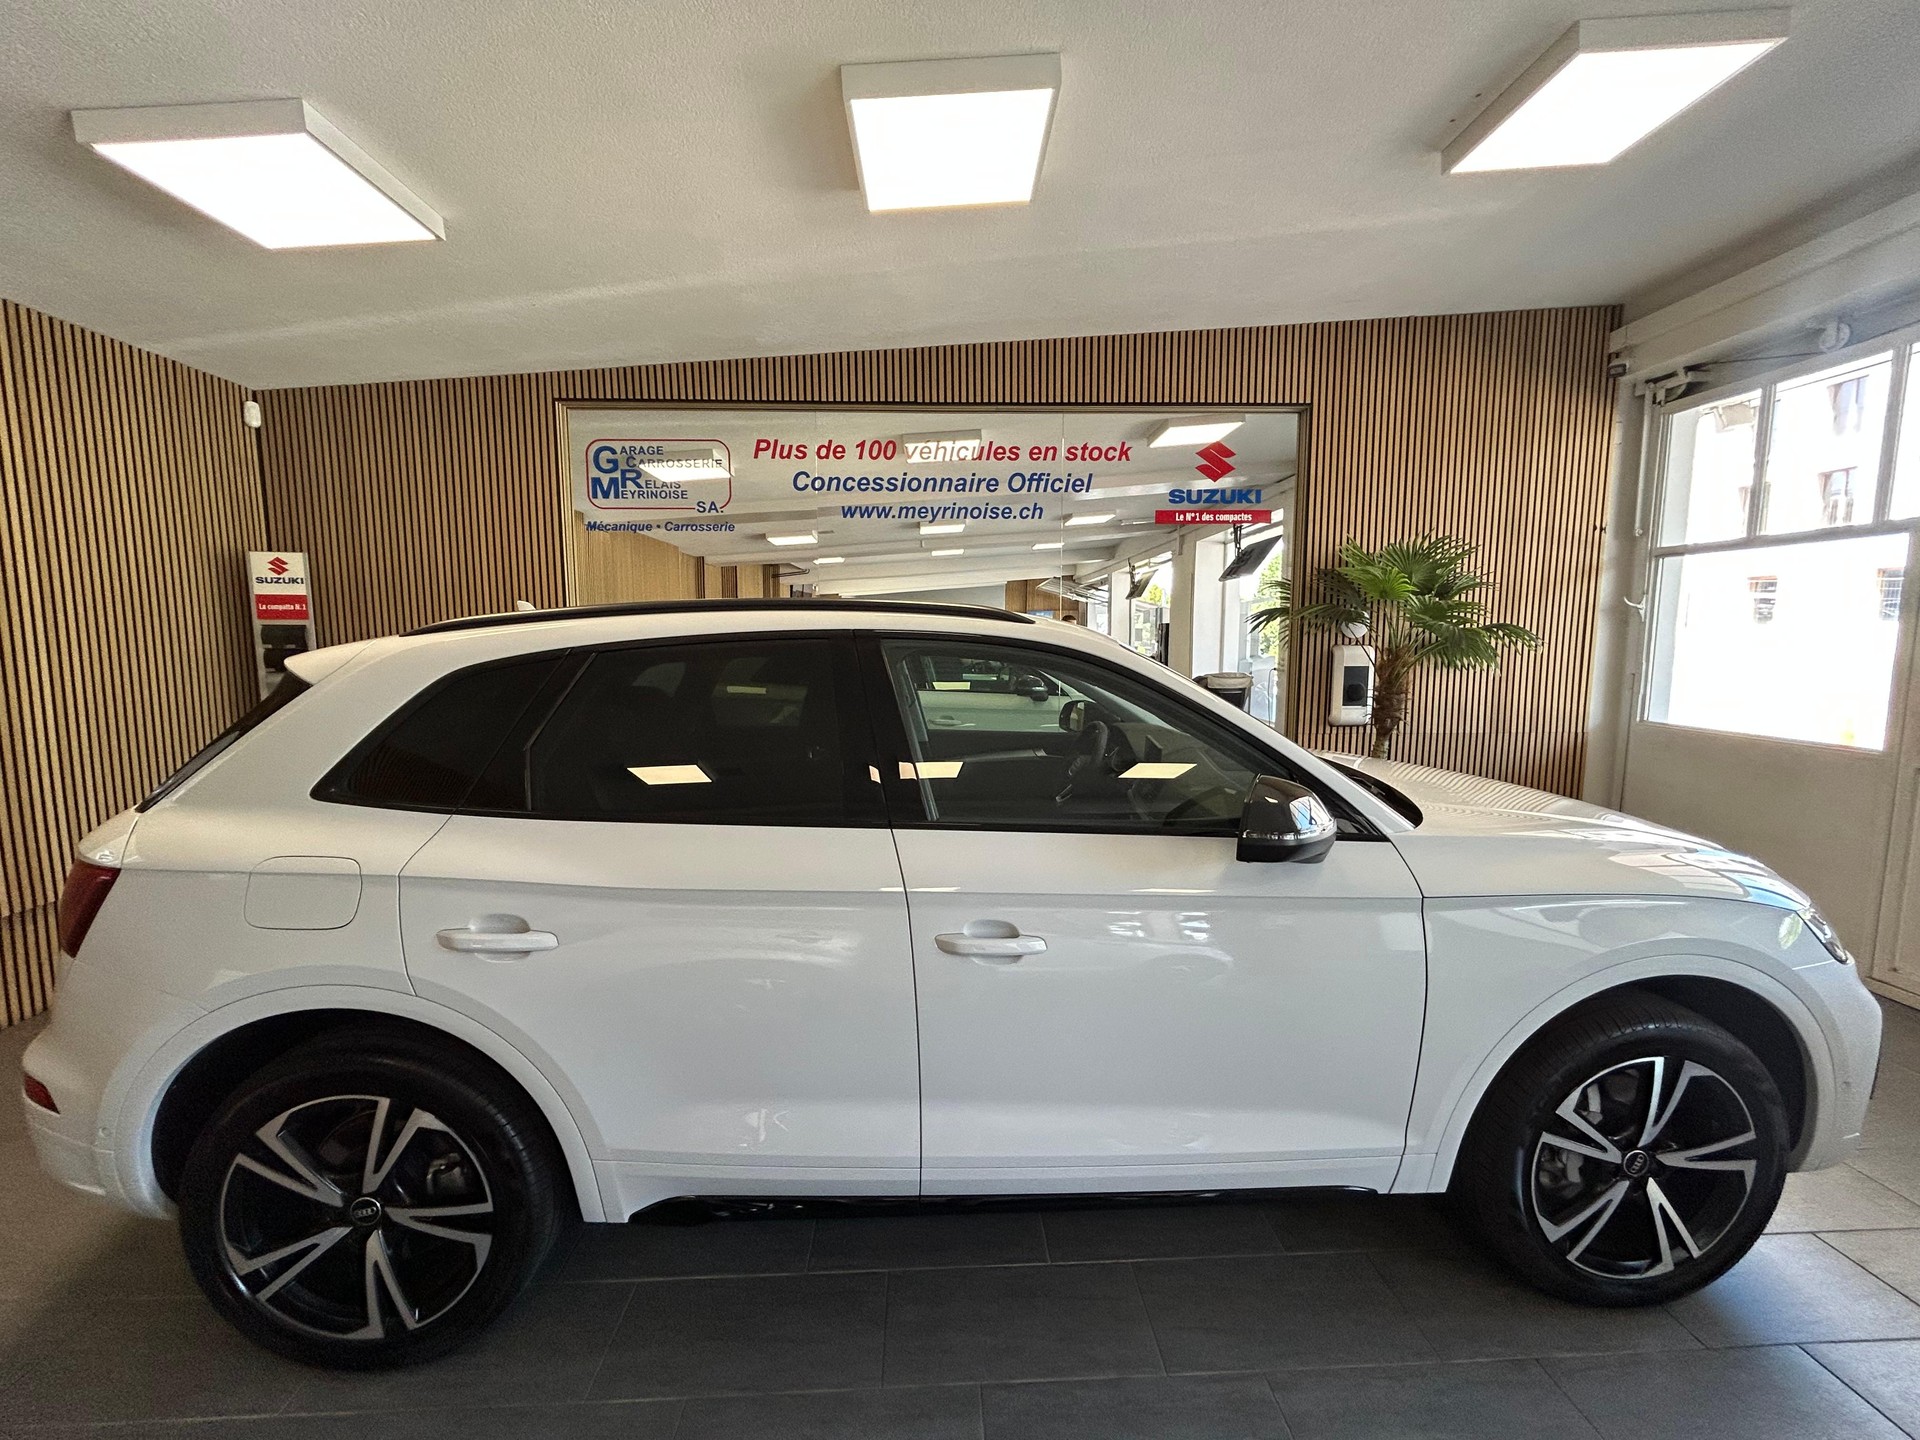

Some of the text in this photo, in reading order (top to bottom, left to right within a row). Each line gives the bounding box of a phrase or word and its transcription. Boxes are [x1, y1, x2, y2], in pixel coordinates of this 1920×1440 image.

[753, 438, 1132, 462] Plus de 100 véhicules en stock
[625, 455, 723, 469] CARROSSERIE
[620, 468, 681, 489] RELAIS
[792, 470, 1093, 493] Concessionnaire Officiel
[590, 477, 688, 500] MEYRINOISE
[1168, 488, 1262, 504] SUZUKI
[841, 502, 1044, 524] www.meyrinoise.ch
[1175, 512, 1184, 521] Le
[1201, 512, 1214, 521] des
[1215, 512, 1253, 523] compactes
[585, 521, 735, 534] Mécanique Carrosserie
[255, 576, 304, 585] SUZUKI
